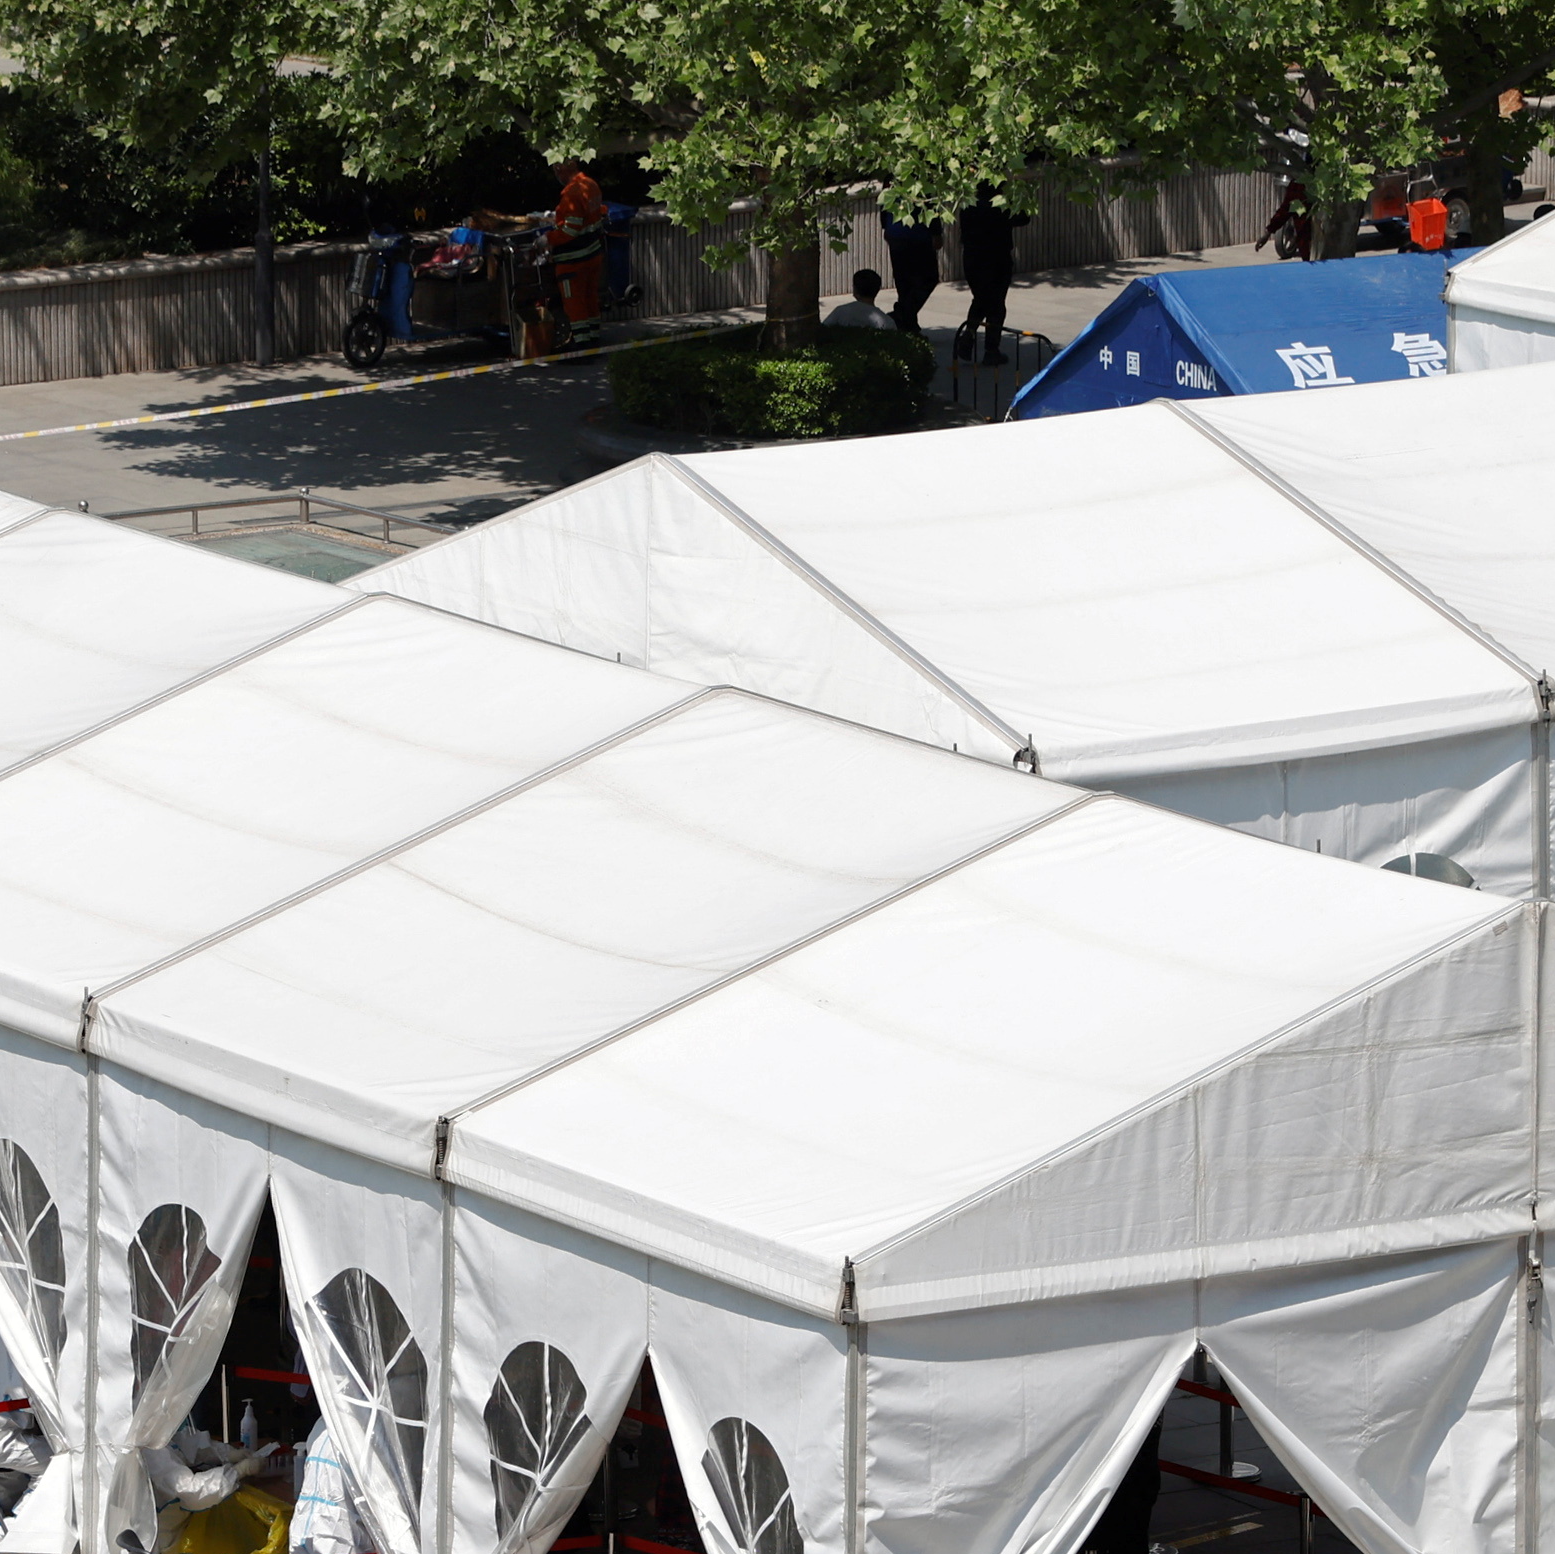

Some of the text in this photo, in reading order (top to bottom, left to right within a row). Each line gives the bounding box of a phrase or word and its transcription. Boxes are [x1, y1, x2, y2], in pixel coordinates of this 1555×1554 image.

[1098, 344, 1218, 392] 中国 CHINA
[1275, 332, 1448, 389] 应急
